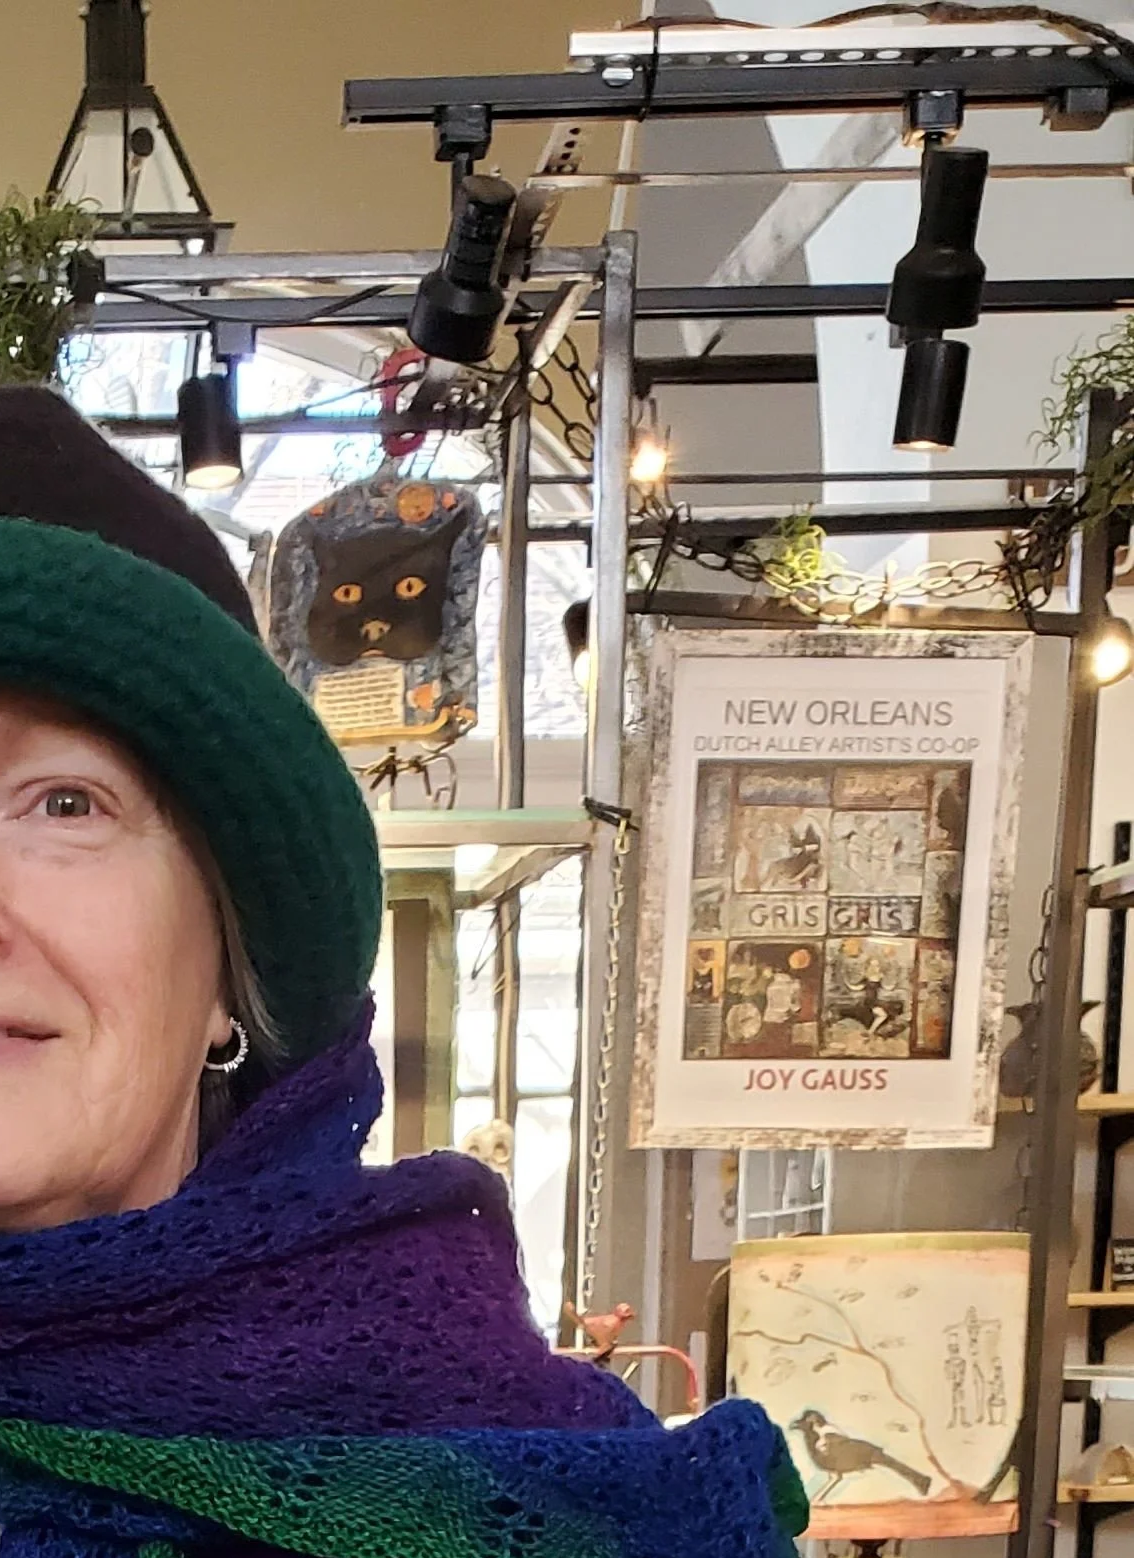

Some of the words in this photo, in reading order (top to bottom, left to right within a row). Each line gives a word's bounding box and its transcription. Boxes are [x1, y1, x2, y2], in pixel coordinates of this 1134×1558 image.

[724, 700, 798, 725] NEW
[805, 700, 954, 726] ORLEANS
[693, 735, 761, 752] DUTCH
[765, 736, 827, 752] ALLEY
[828, 736, 913, 753] ARTIST'S
[916, 737, 981, 753] CO-OP
[747, 903, 820, 929] GRIS
[744, 1068, 796, 1091] JOY
[801, 1068, 889, 1091] GAUSS
